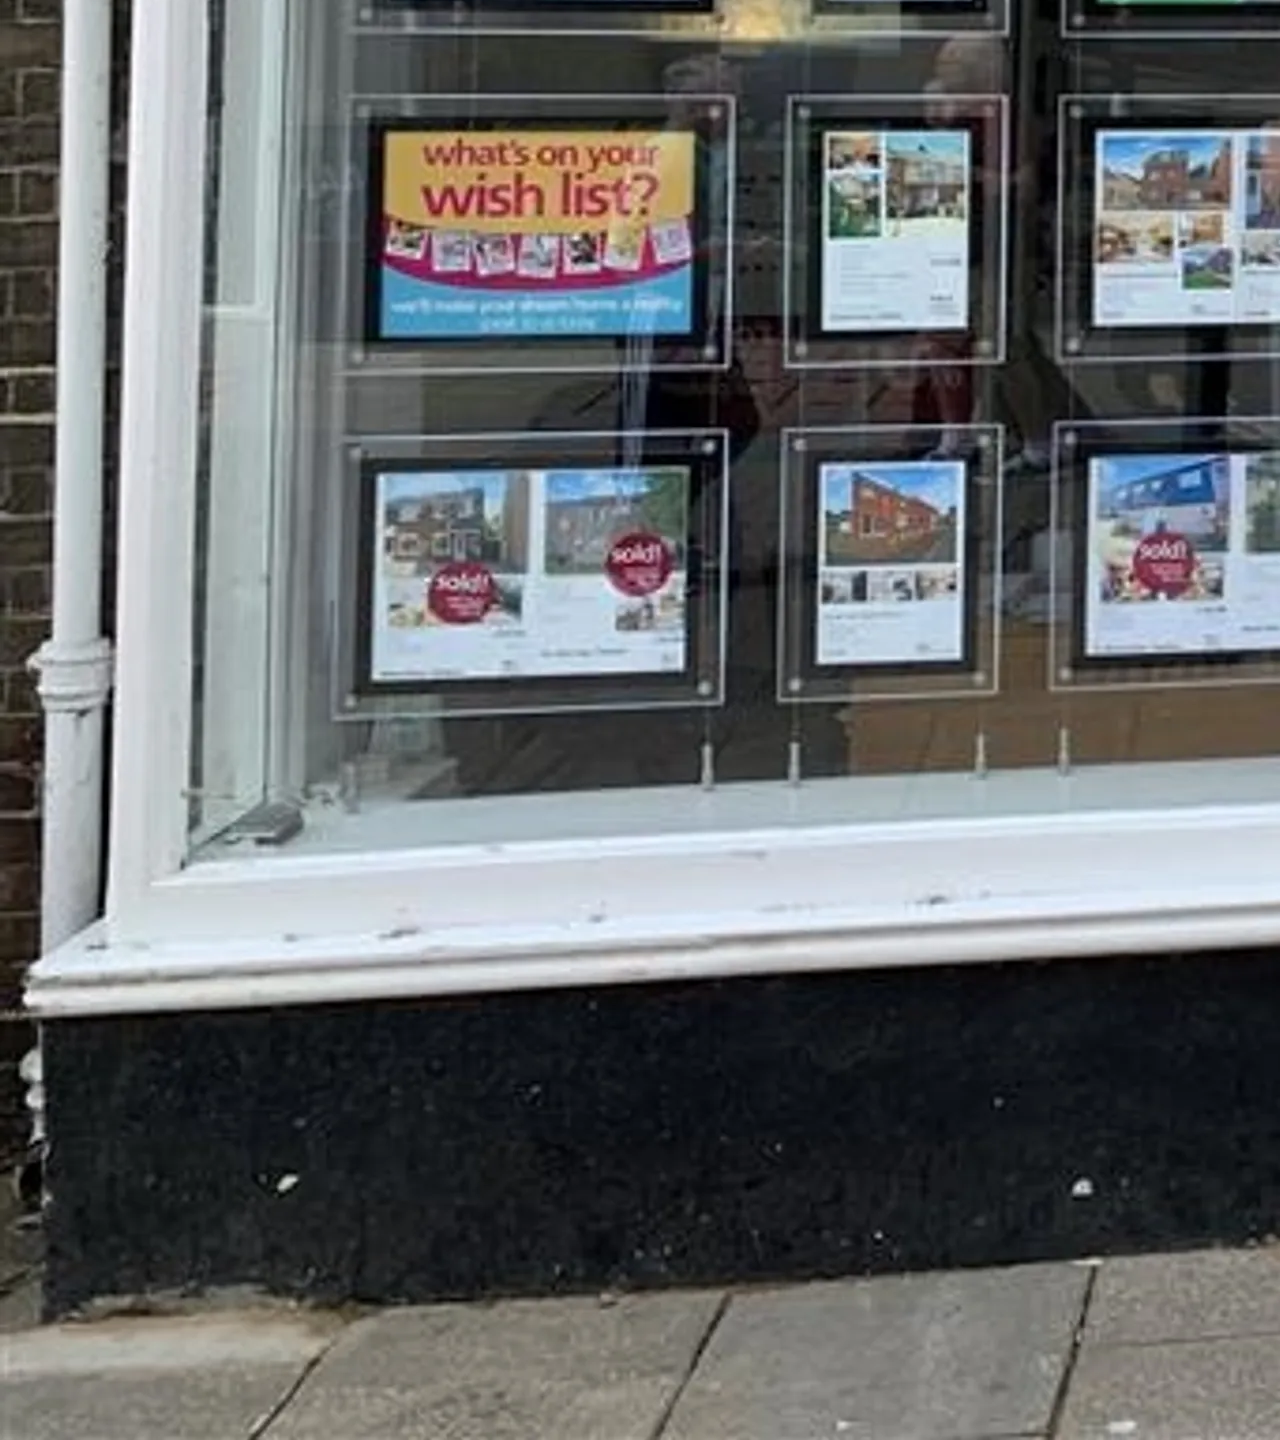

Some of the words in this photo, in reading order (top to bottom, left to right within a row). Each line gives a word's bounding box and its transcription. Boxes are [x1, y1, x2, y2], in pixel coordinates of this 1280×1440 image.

[423, 138, 531, 166] what's
[537, 144, 578, 165] on
[587, 143, 659, 172] your
[420, 173, 545, 216] wish
[561, 172, 659, 216] list?
